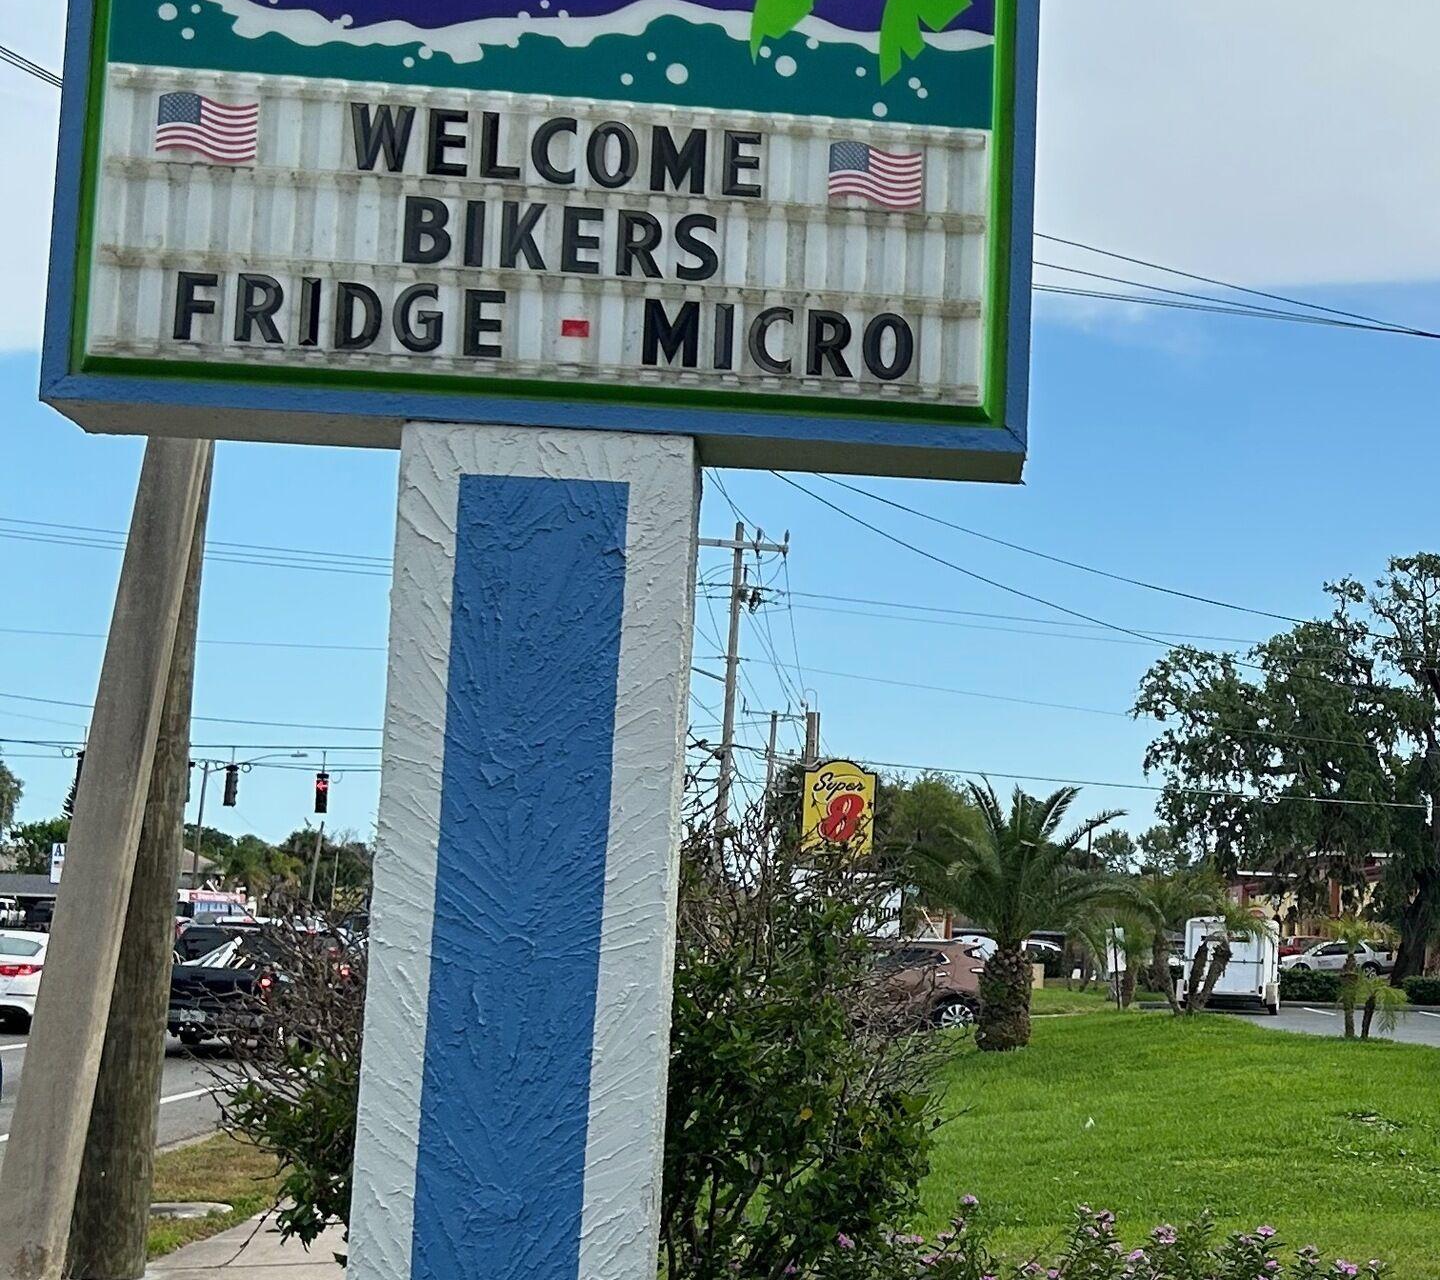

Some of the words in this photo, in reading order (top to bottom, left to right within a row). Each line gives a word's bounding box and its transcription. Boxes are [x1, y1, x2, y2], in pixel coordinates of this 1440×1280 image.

[350, 100, 763, 198] WELCOME
[402, 196, 720, 282] BIKERS
[172, 273, 508, 359] FRIDGE
[641, 297, 914, 381] MICRO
[813, 772, 866, 801] Super
[817, 793, 865, 843] 8
